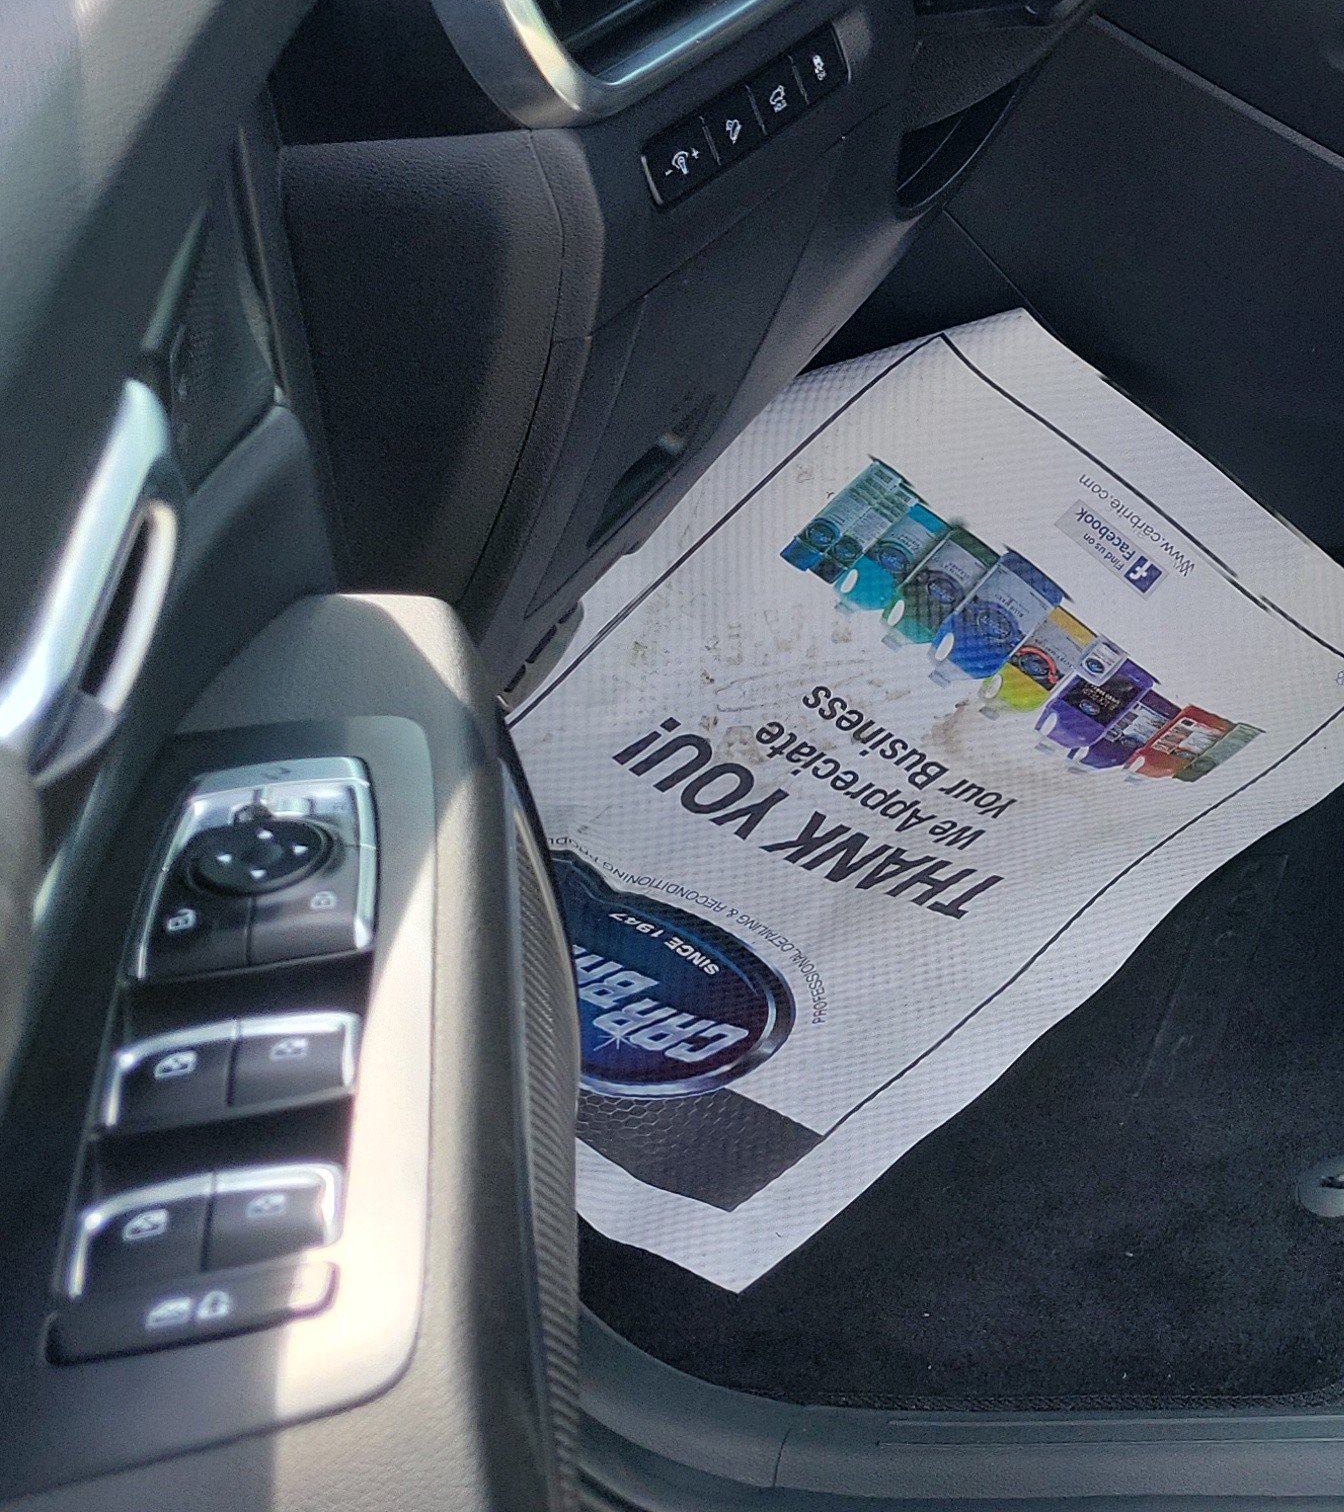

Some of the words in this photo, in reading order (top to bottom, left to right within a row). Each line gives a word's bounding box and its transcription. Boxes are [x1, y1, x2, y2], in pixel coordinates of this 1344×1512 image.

[1074, 507, 1137, 562] Facebook
[1082, 533, 1097, 546] on
[1094, 542, 1107, 555] us
[1103, 551, 1126, 571] Find
[801, 685, 950, 792] Business
[612, 716, 789, 841] YOU!
[754, 720, 937, 834] Appreciate
[938, 777, 1018, 820] Your
[923, 818, 986, 851] We
[601, 860, 727, 914] RECONDITIONING
[758, 810, 1005, 920] THANK
[608, 910, 665, 937] 1947
[726, 907, 739, 919] &
[736, 914, 795, 952] DETAILING
[571, 944, 657, 1010] BR
[662, 936, 720, 976] SINCE
[788, 948, 827, 1024] PROFESSIONAL
[592, 994, 751, 1064] CAR
